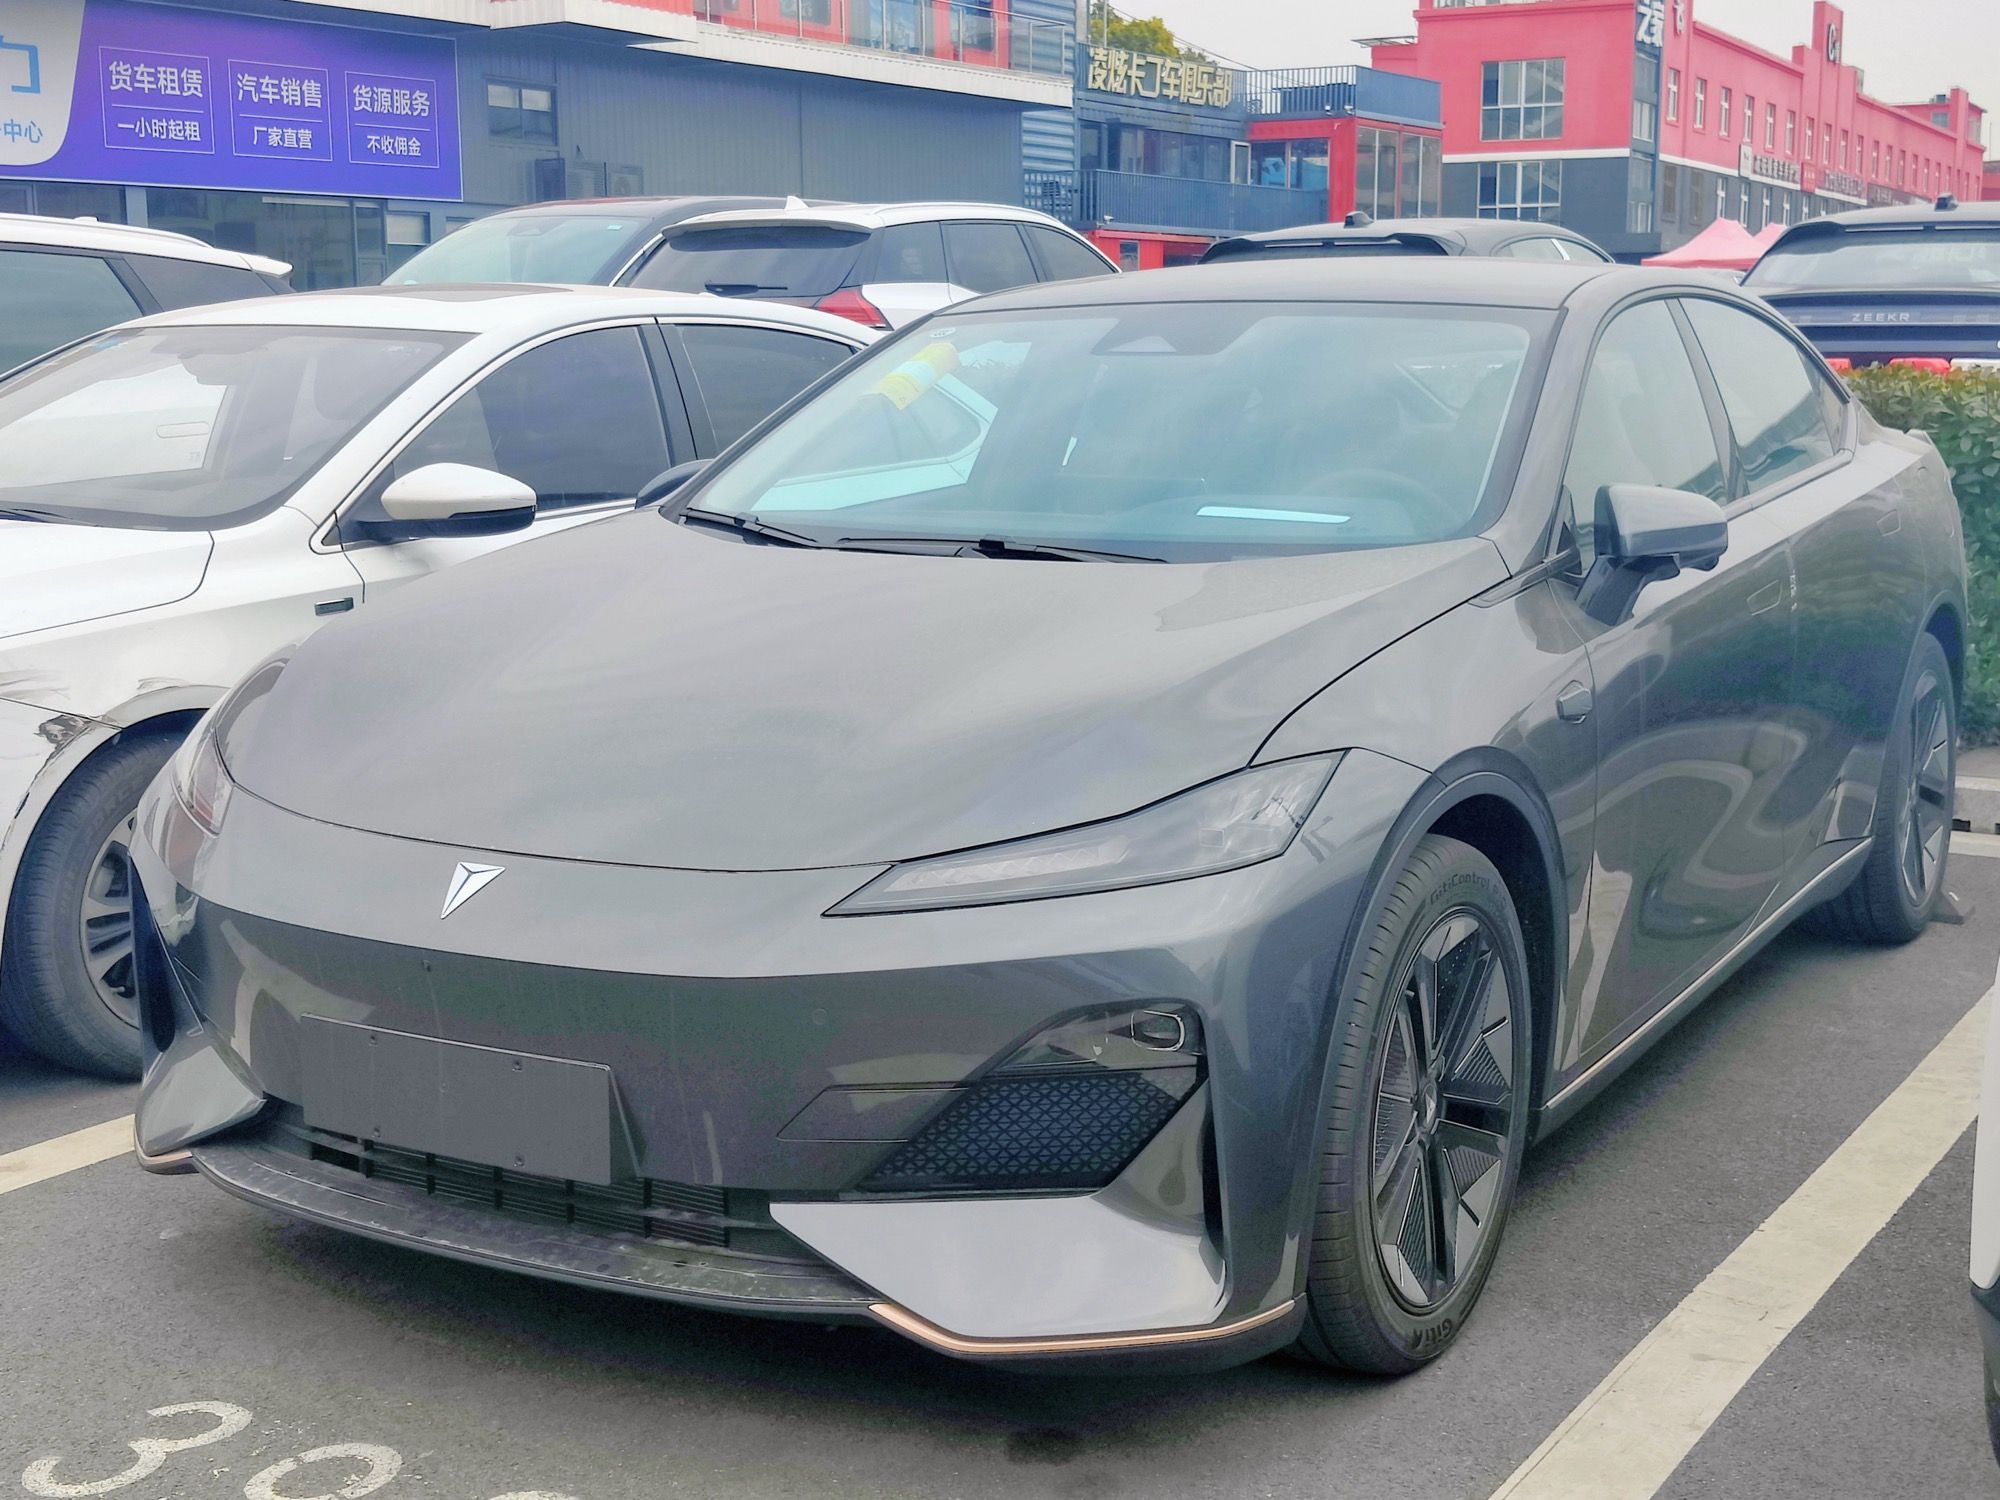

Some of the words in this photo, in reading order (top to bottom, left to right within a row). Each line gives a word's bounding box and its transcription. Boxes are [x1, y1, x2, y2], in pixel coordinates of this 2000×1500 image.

[109, 60, 203, 98] 货车租赁
[236, 73, 322, 108] 汽车销售
[352, 84, 430, 117] 货源服务
[0, 118, 44, 144] 中心
[117, 116, 201, 142] 一小时起租
[253, 126, 312, 149] 厂家直营
[367, 135, 422, 156] 不收佣金
[1851, 312, 1911, 322] ZEEKR
